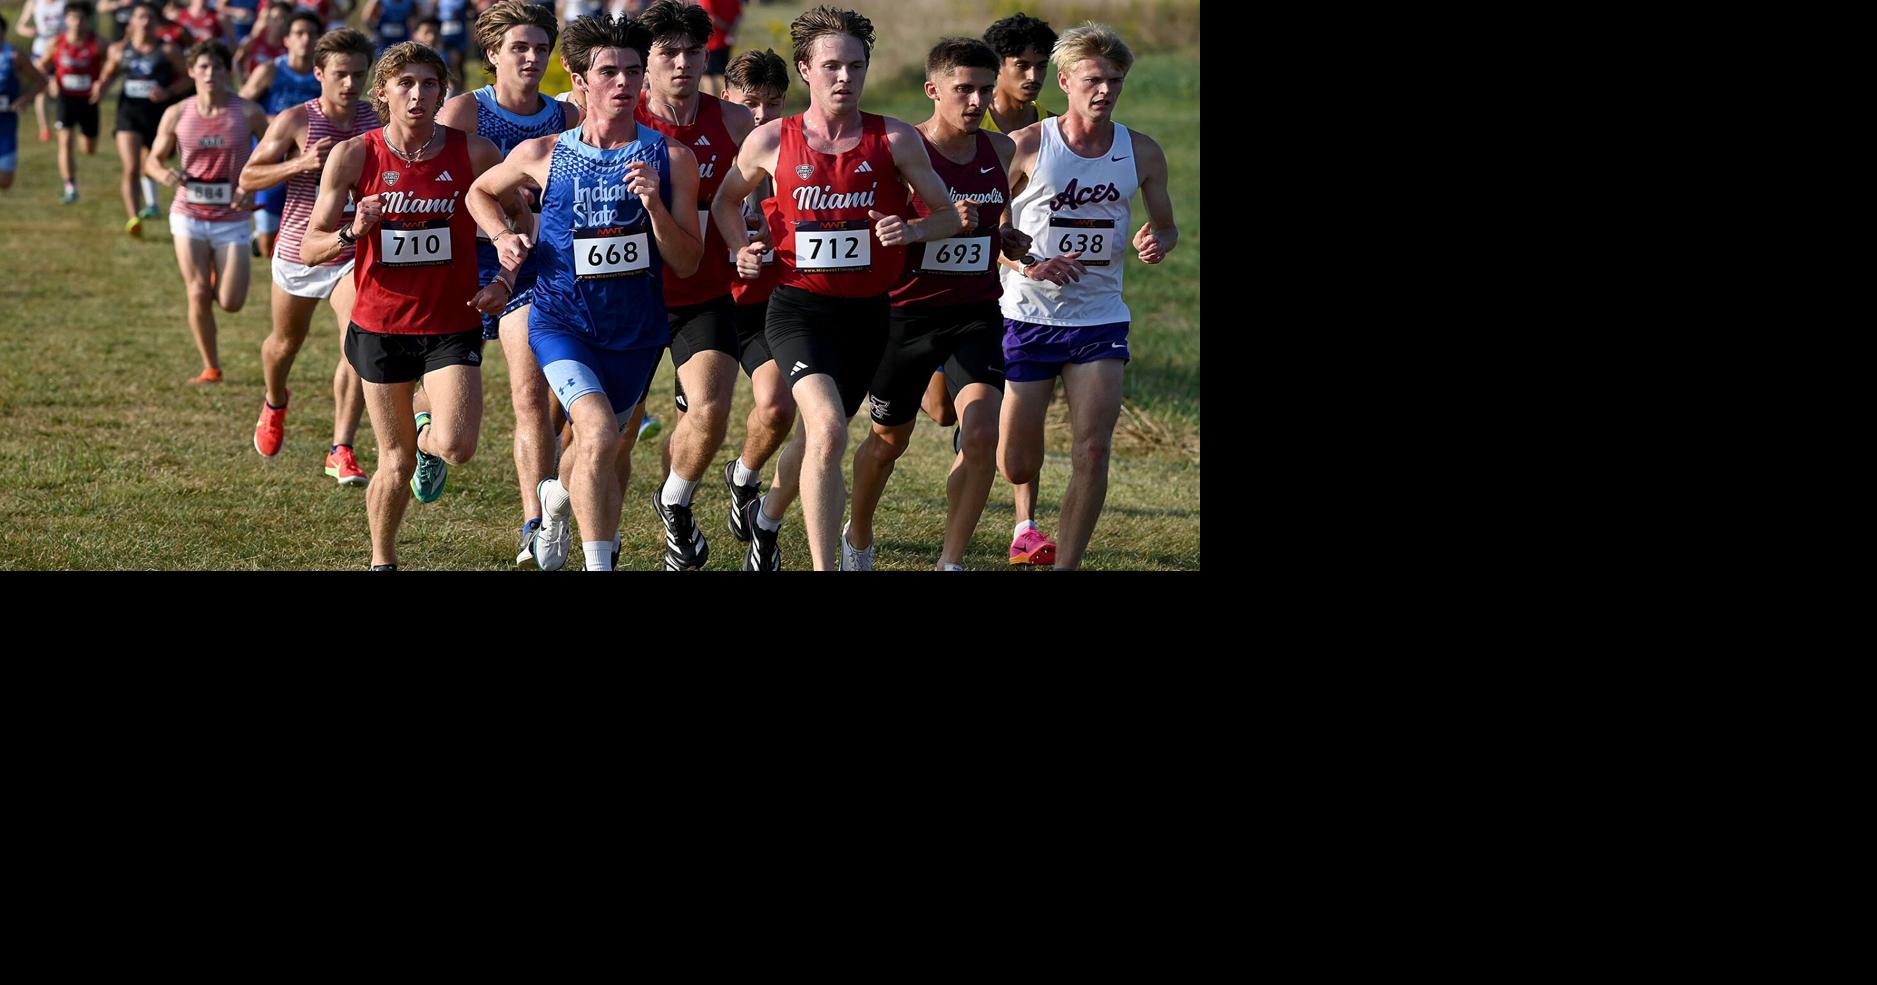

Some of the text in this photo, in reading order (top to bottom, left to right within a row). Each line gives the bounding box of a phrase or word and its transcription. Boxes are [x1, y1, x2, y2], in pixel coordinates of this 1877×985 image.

[573, 177, 641, 203] Indian
[792, 181, 878, 210] Miami
[381, 191, 459, 213] Miami
[573, 203, 642, 227] State
[393, 235, 440, 255] 710
[588, 242, 638, 266] 668
[809, 237, 859, 259] 712
[936, 244, 981, 264] 693
[1059, 234, 1103, 253] 638
